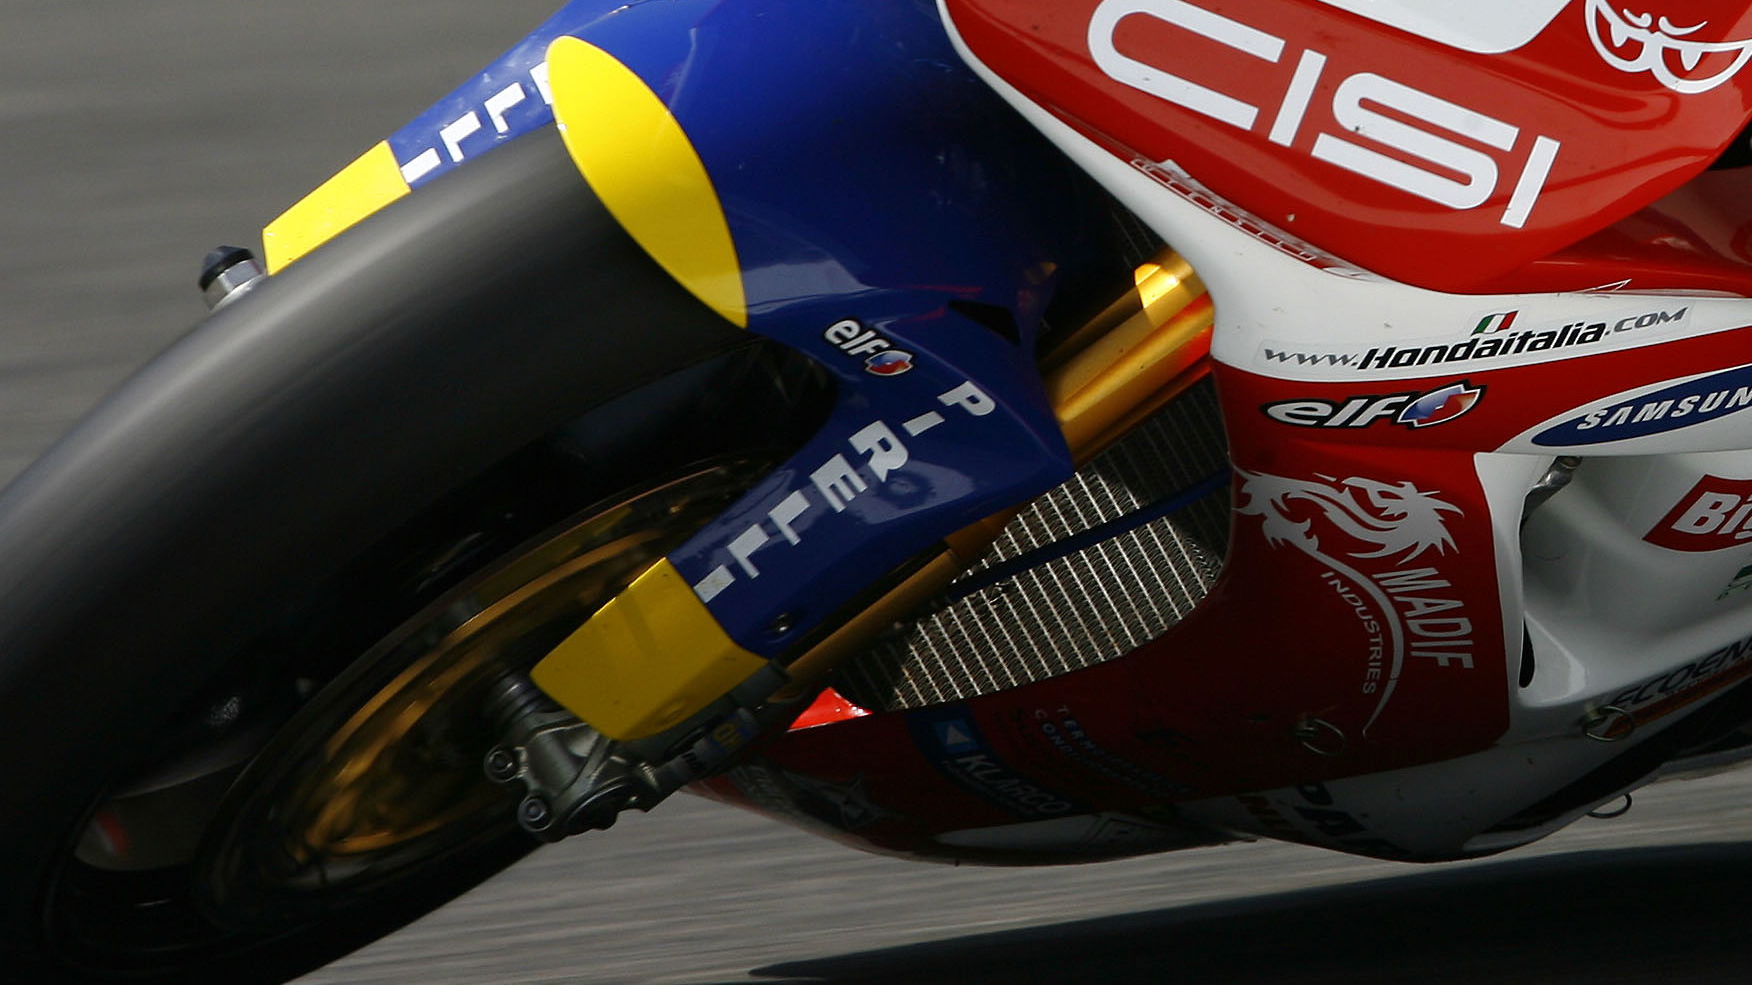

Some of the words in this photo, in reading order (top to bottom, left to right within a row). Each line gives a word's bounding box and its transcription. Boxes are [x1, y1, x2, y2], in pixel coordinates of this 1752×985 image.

[824, 319, 890, 356] elf
[1265, 394, 1407, 429] elf
[692, 380, 997, 604] PIRELLI
[1320, 571, 1384, 695] INDUSTRIES
[1371, 566, 1475, 669] MADIF
